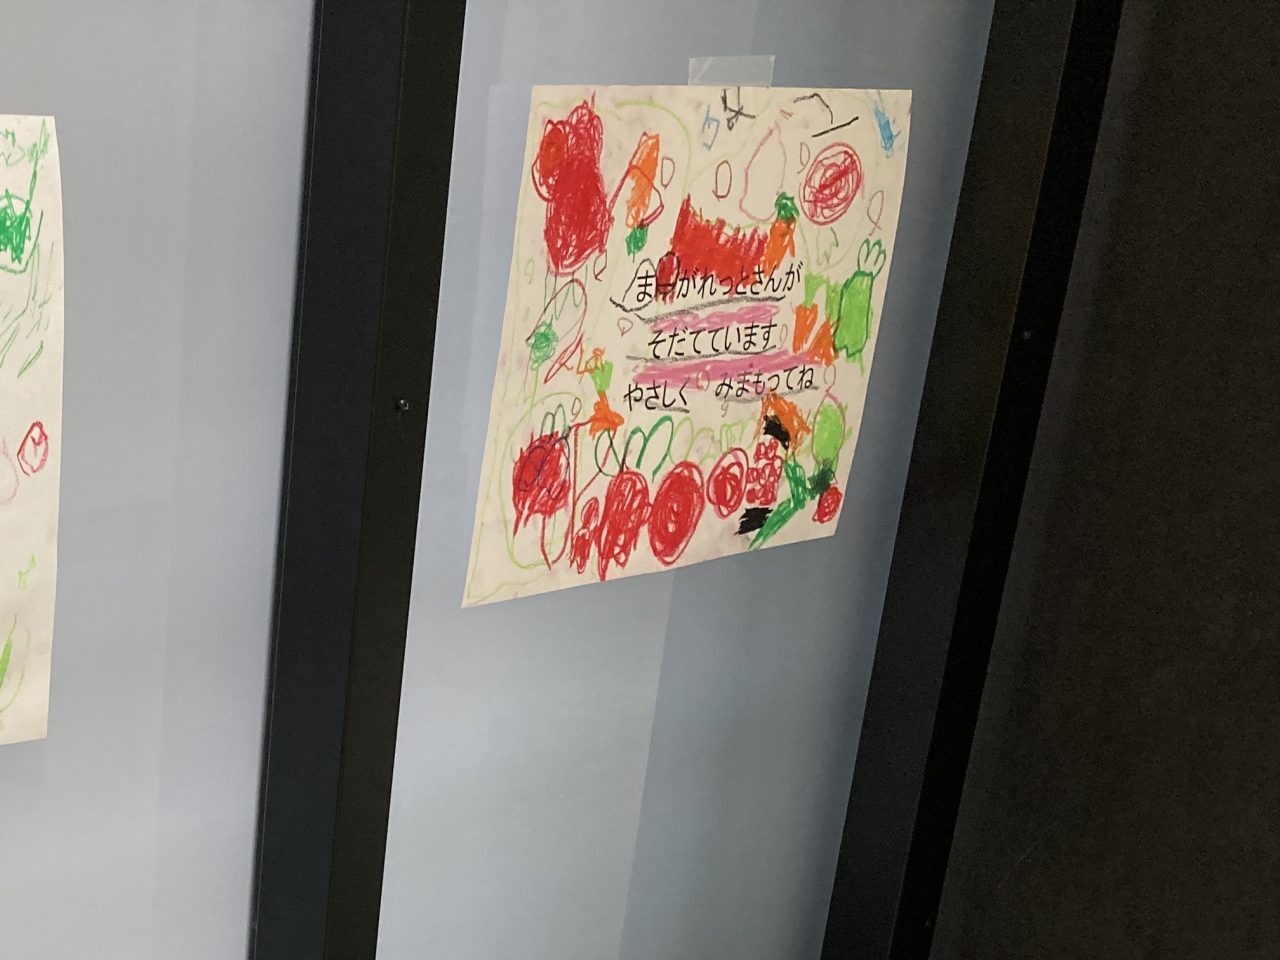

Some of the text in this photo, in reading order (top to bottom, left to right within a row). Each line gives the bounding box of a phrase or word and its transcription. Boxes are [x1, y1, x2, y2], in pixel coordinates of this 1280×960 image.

[636, 261, 805, 303] まーがれっとさんが
[647, 318, 779, 360] そだてています
[623, 363, 815, 412] やさしく みまもってね
